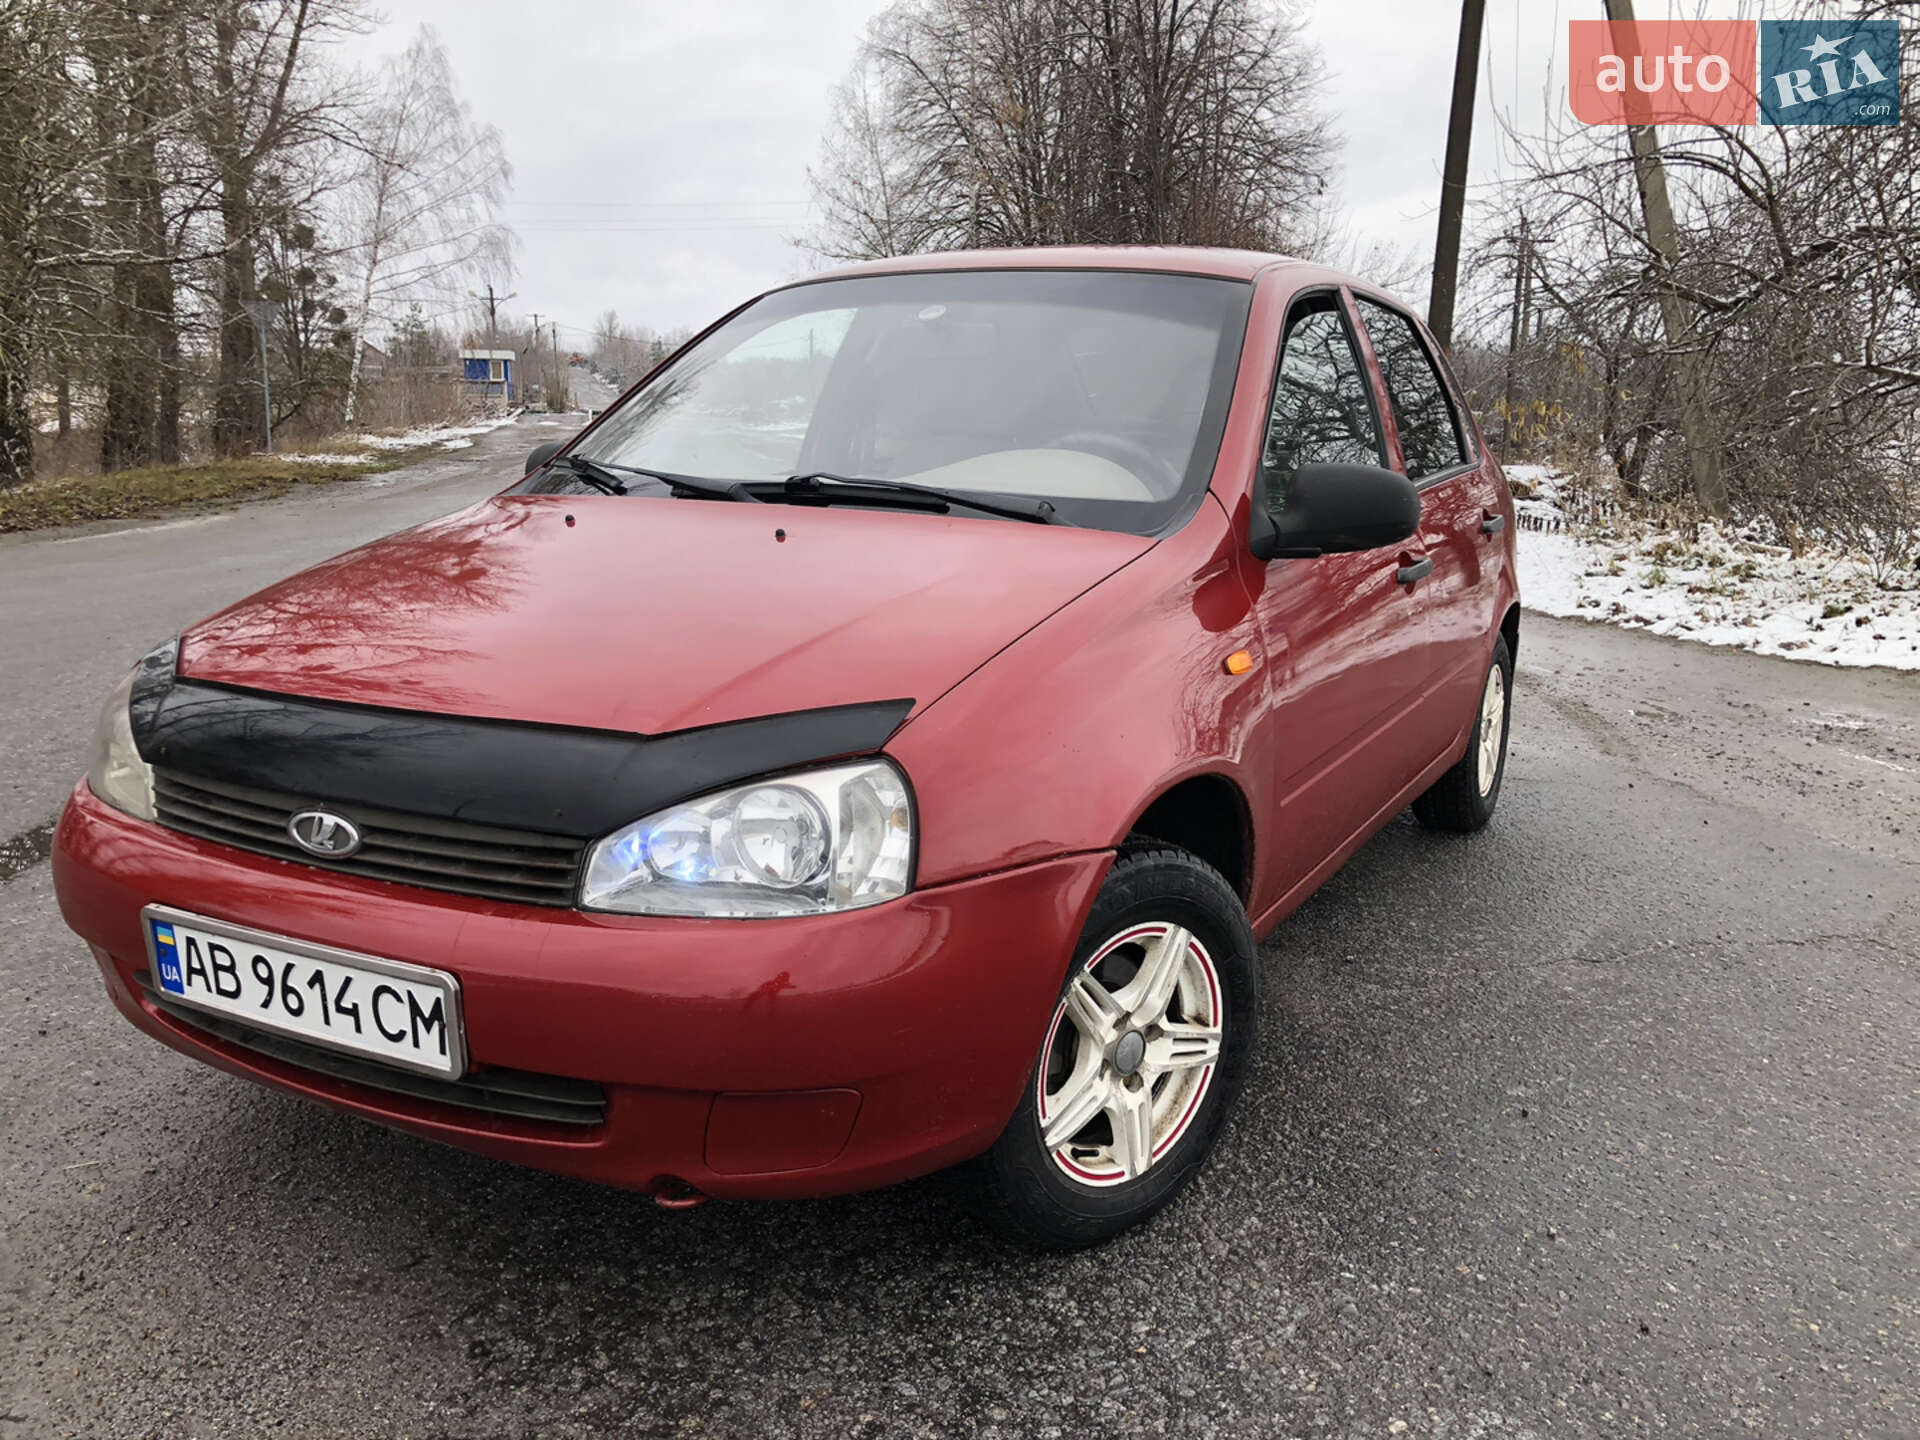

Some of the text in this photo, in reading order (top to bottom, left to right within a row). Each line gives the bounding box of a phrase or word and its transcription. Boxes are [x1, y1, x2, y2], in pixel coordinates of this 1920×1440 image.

[162, 963, 181, 984] UA
[185, 936, 447, 1056] AB 9614 CM
